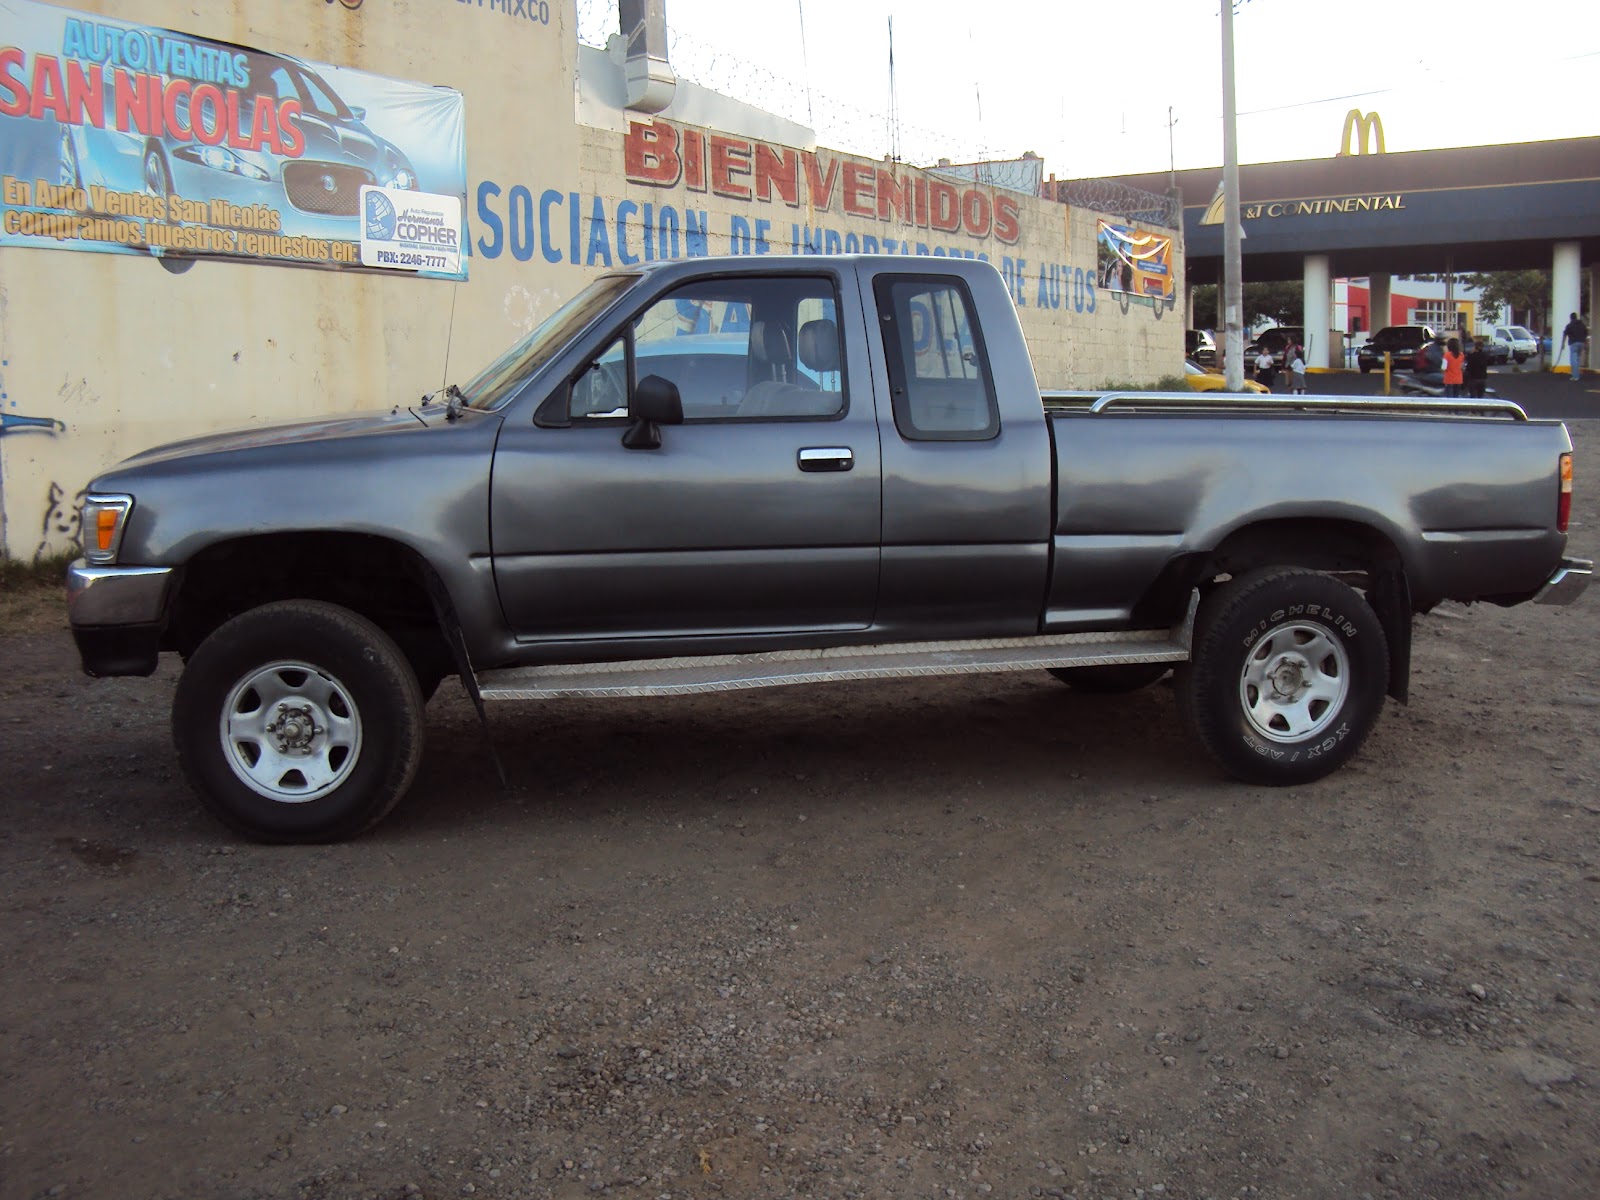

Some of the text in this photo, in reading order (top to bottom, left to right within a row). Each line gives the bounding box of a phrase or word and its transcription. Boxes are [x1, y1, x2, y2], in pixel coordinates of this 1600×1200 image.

[63, 17, 250, 89] AUTO VENTAS
[0, 47, 306, 158] SAN NICOLAS
[3, 175, 281, 231] En Auto Ventas San Nicolás
[623, 120, 1020, 246] BIENVENIDOS
[1267, 195, 1406, 218] CONTINENTAL
[145, 221, 234, 253] nuestros
[236, 231, 329, 262] repuestos
[397, 223, 457, 245] COPHER
[468, 180, 708, 267] SOCIACION
[377, 251, 447, 268] PBX: 2246-7777
[1002, 255, 1096, 314] DE AUTOS
[1243, 604, 1357, 647] MICHELIN
